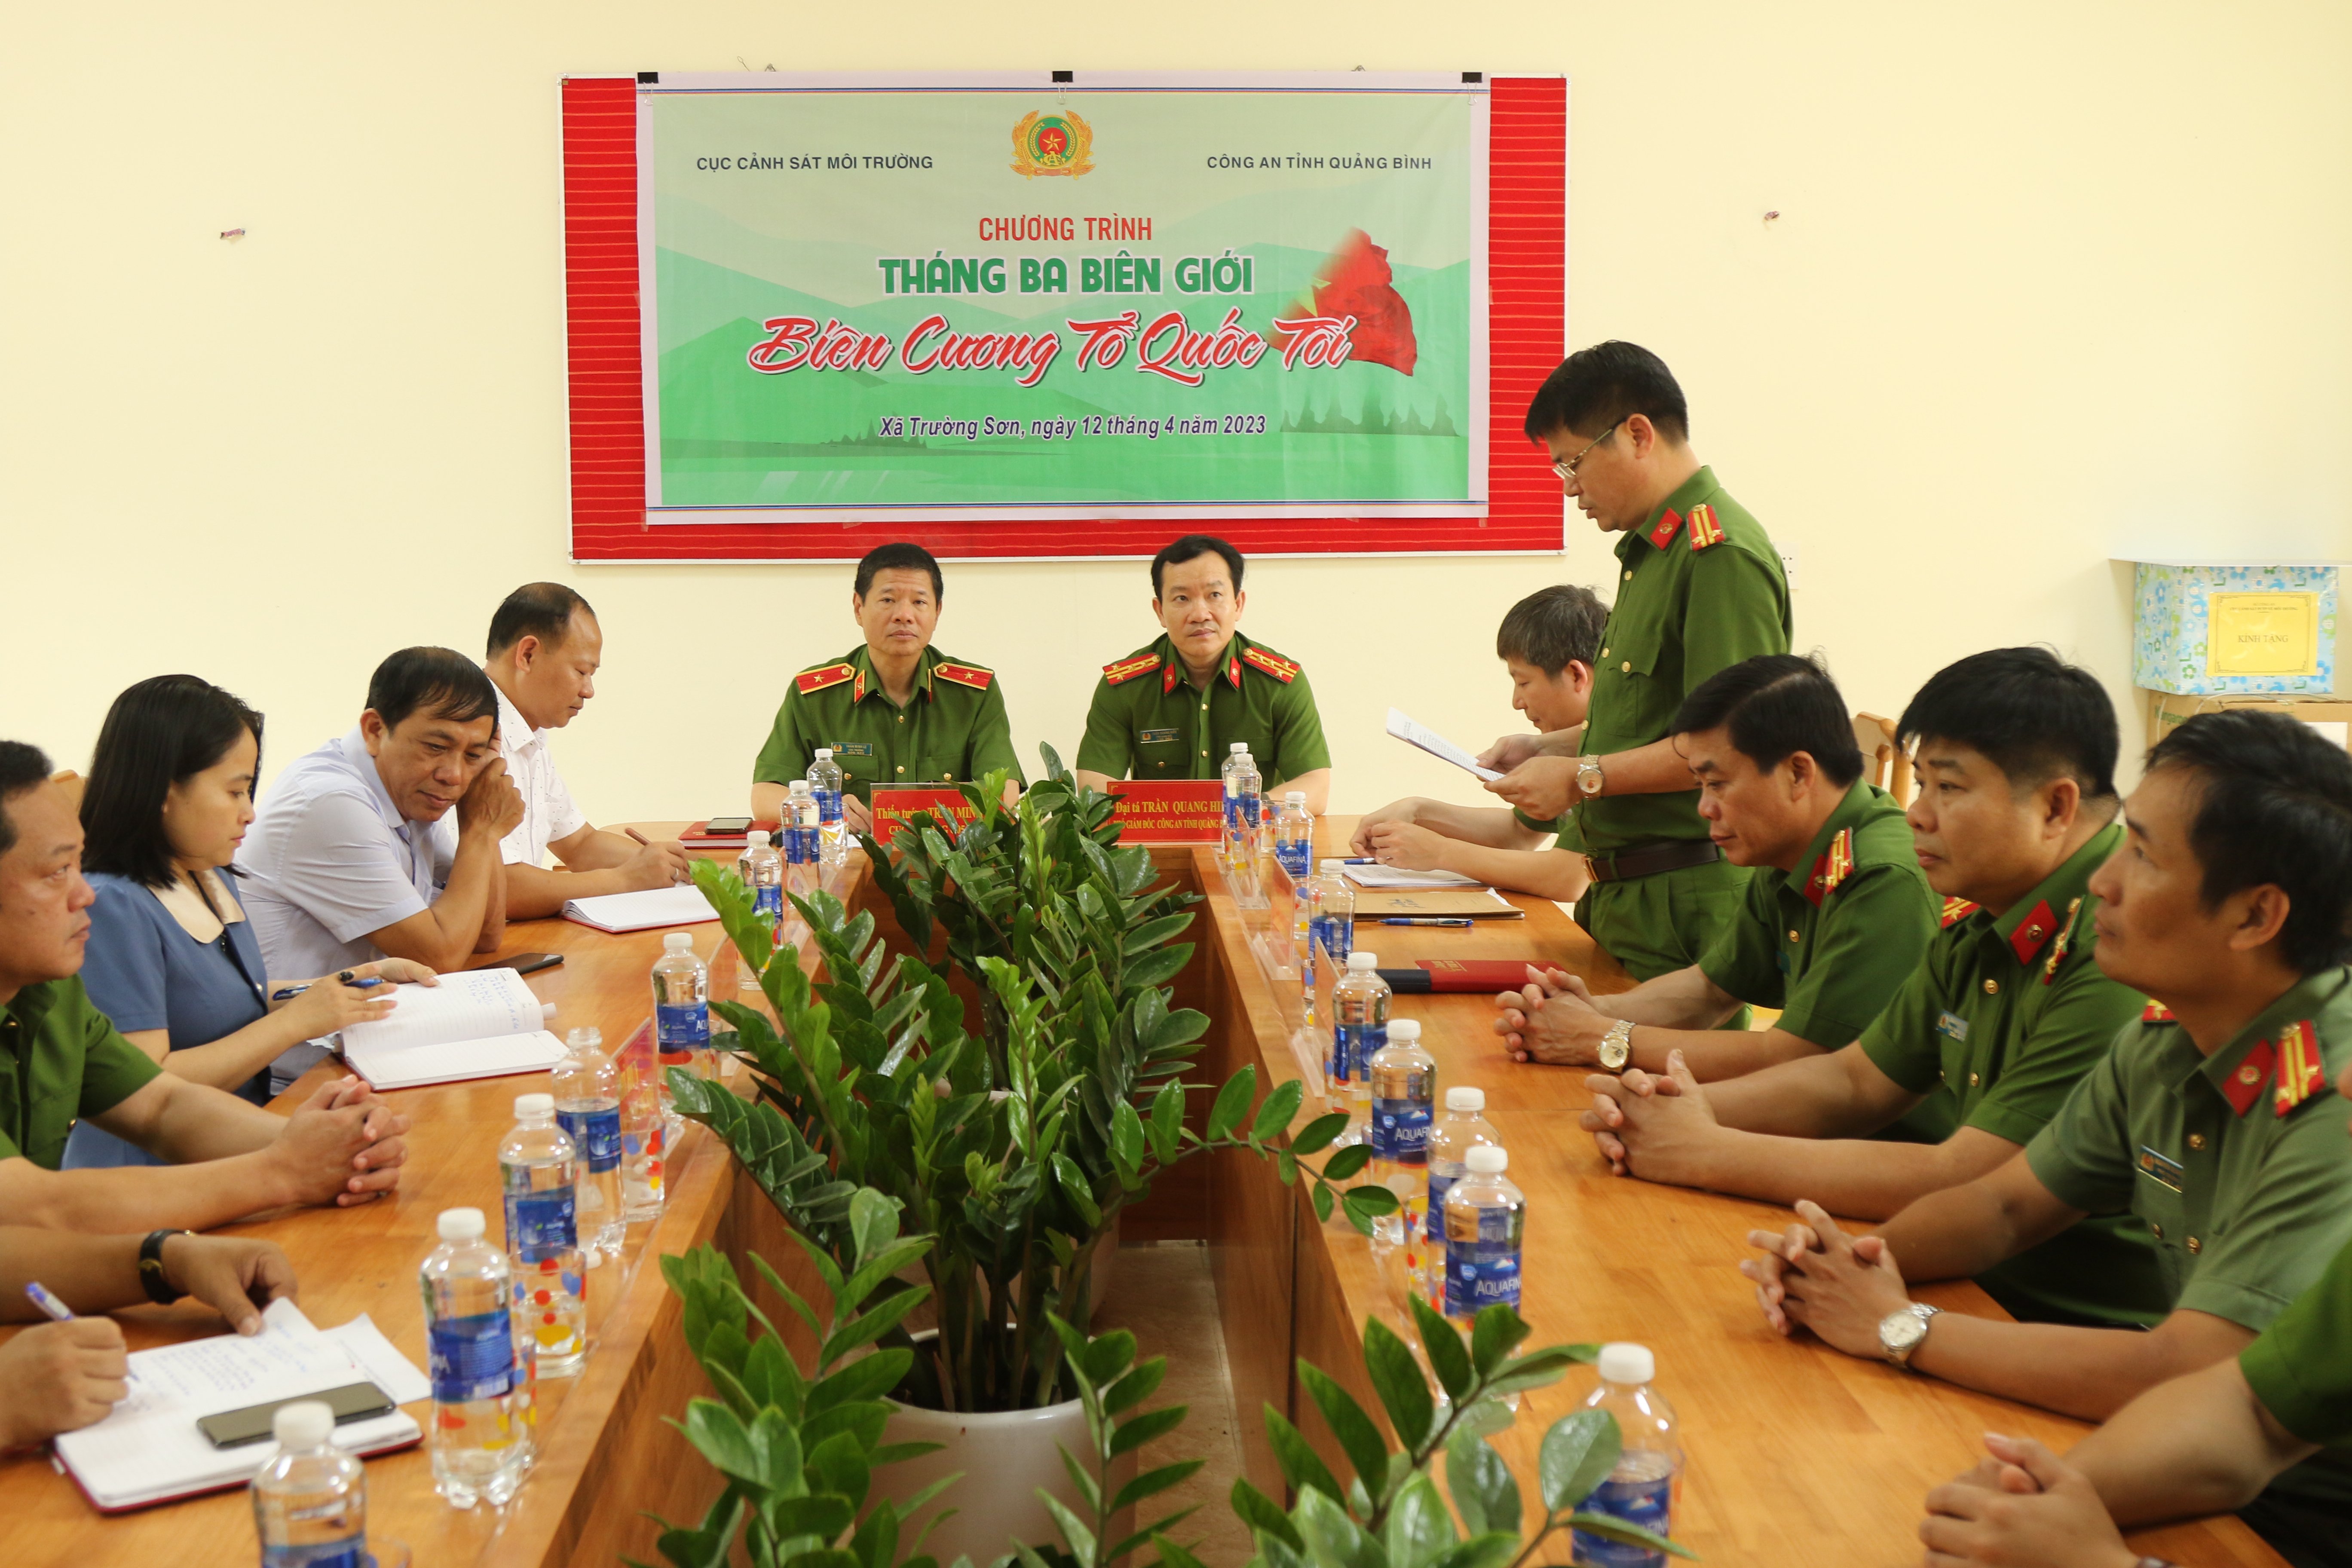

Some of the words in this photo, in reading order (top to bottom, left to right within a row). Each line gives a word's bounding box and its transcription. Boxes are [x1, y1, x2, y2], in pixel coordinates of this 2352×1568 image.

[697, 157, 732, 172] CỤC
[737, 153, 784, 170] CẢNH
[790, 153, 821, 169] SÁT
[827, 153, 857, 169] MÔI
[863, 153, 933, 169] TRƯỜNG
[1207, 154, 1254, 169] CÔNG
[1259, 157, 1281, 168] AN
[1287, 153, 1324, 169] TỈNH
[1329, 153, 1388, 169] QUẢNG
[1393, 154, 1432, 169] BÌNH
[979, 215, 1075, 241] CHƯƠNG
[1084, 213, 1152, 241] TRÌNH
[878, 251, 1007, 294] THÁNG
[1019, 258, 1068, 293] BA
[1081, 250, 1161, 293] BIÊN
[1174, 249, 1254, 293] GIỚI
[749, 316, 891, 371] Biên
[902, 314, 1059, 386] Cương
[1067, 311, 1138, 370] Tổ
[1137, 307, 1266, 386] Quốc
[1274, 316, 1357, 370] Tôi
[880, 416, 903, 435] Xã
[910, 416, 978, 440] Trường
[983, 416, 1025, 439] Sơn,
[1032, 415, 1077, 440] ngày
[1082, 416, 1102, 434] 12
[1107, 415, 1159, 439] tháng
[1164, 416, 1175, 434] 4
[1179, 415, 1218, 434] năm
[1223, 415, 1266, 434] 2023
[1116, 802, 1130, 815] Đại
[1132, 801, 1140, 813] tá
[1142, 798, 1169, 813] TRẦN
[1173, 801, 1208, 815] QUANG
[1157, 818, 1174, 829] CÔNG
[1174, 820, 1182, 828] AN
[1198, 817, 1219, 830] QUẢNG
[1278, 854, 1307, 864] AQUAFINA
